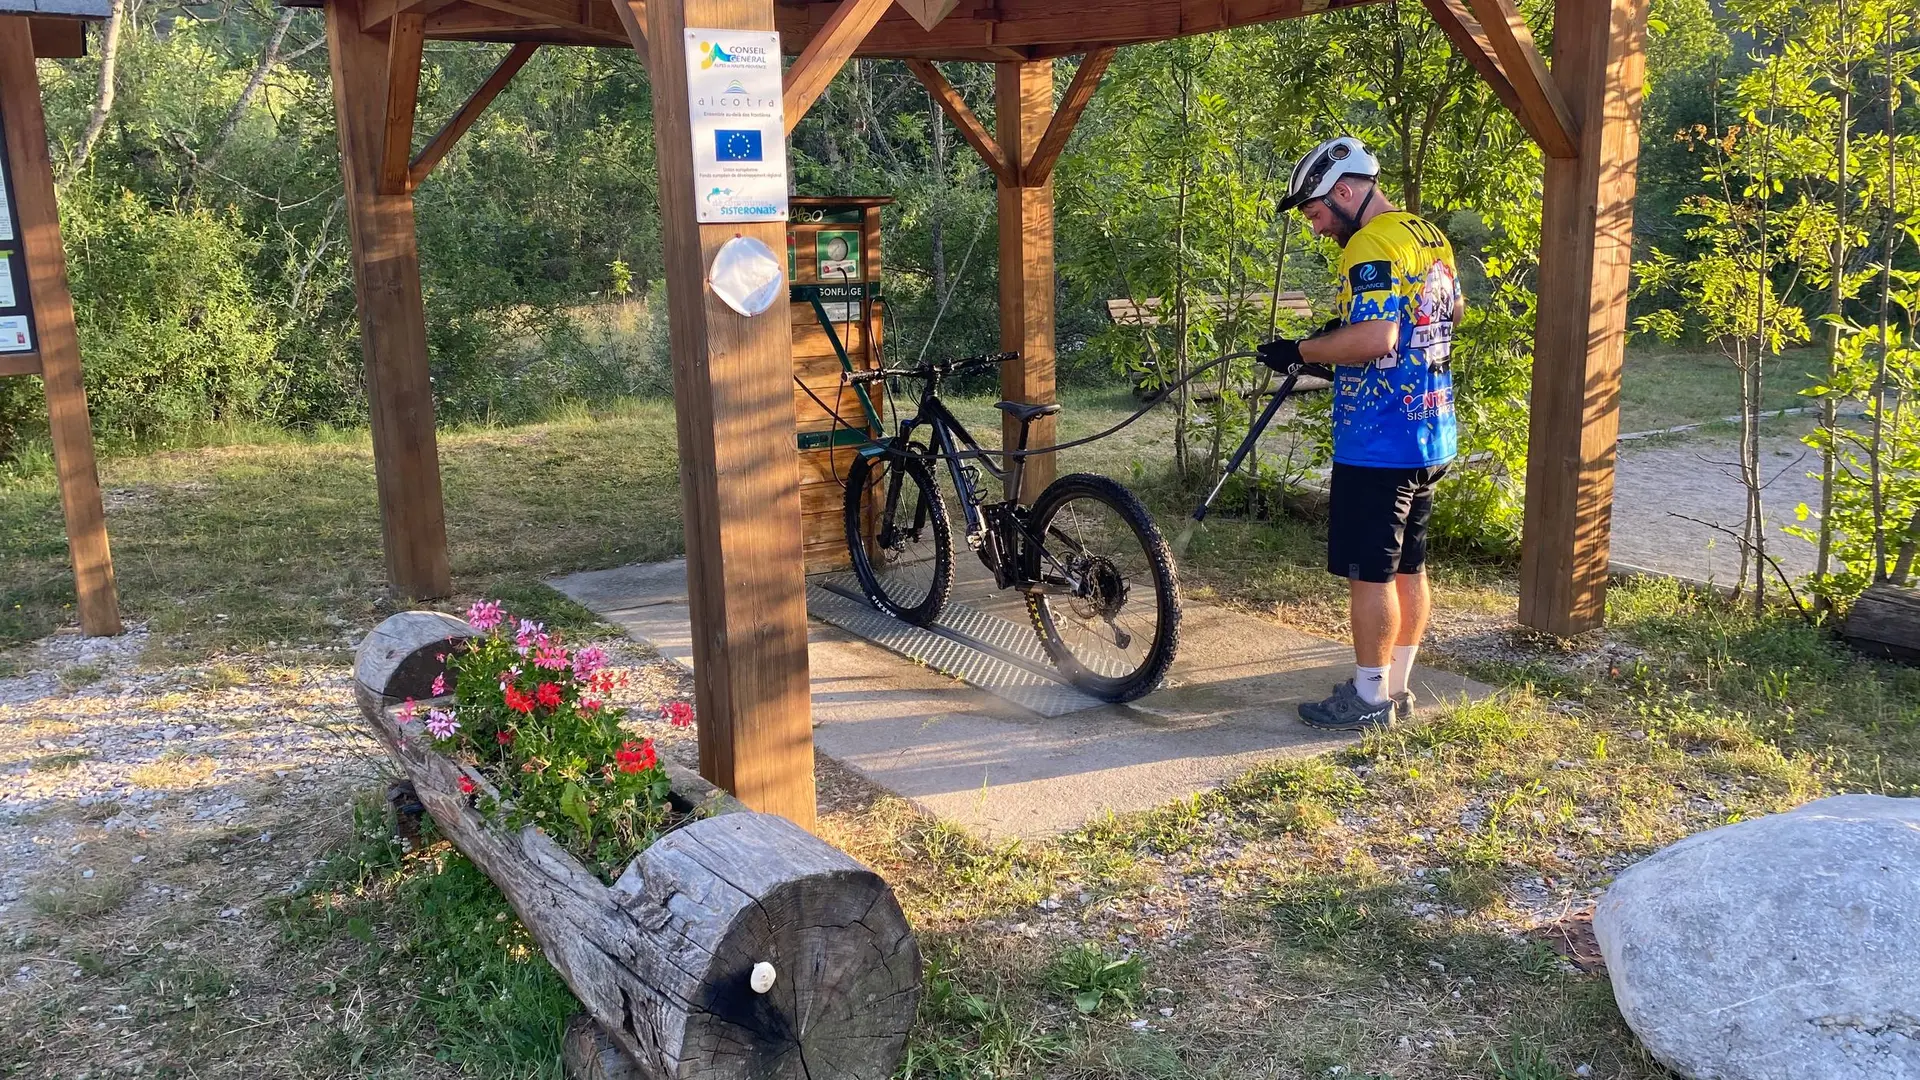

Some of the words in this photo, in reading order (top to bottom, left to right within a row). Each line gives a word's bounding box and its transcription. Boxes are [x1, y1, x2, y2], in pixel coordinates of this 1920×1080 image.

[729, 46, 766, 54] CONSEIL
[698, 96, 774, 107] alcotra
[1353, 282, 1385, 292] SOLANCE
